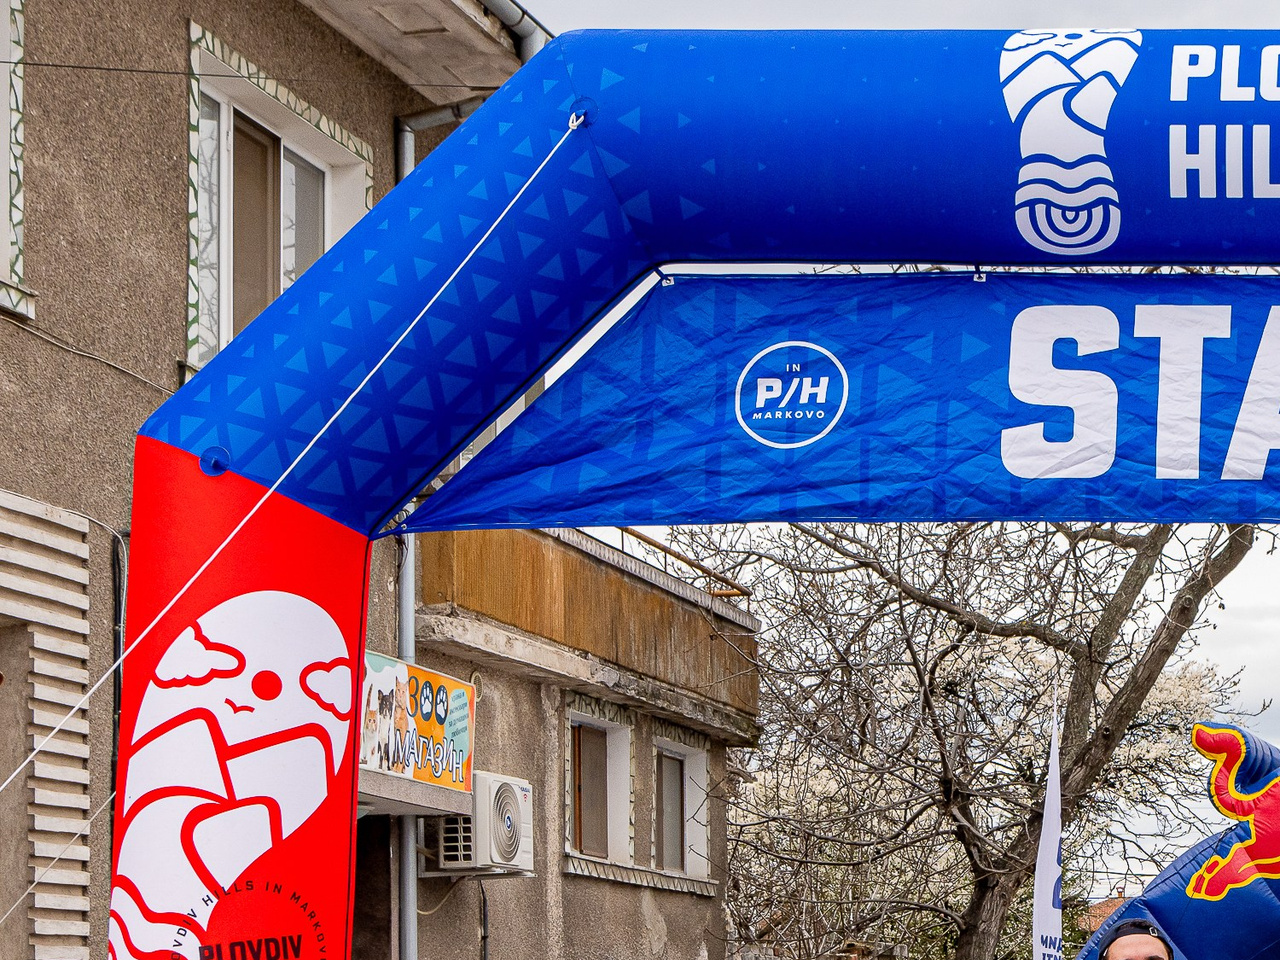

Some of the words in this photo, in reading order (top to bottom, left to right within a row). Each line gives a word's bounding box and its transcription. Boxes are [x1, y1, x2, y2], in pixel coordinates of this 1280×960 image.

[786, 364, 800, 372] IN
[755, 376, 829, 408] P/H
[752, 410, 825, 420] MARKOVO
[395, 728, 464, 782] МАГАЗИН
[202, 880, 254, 907] HILLS
[265, 881, 282, 894] IN
